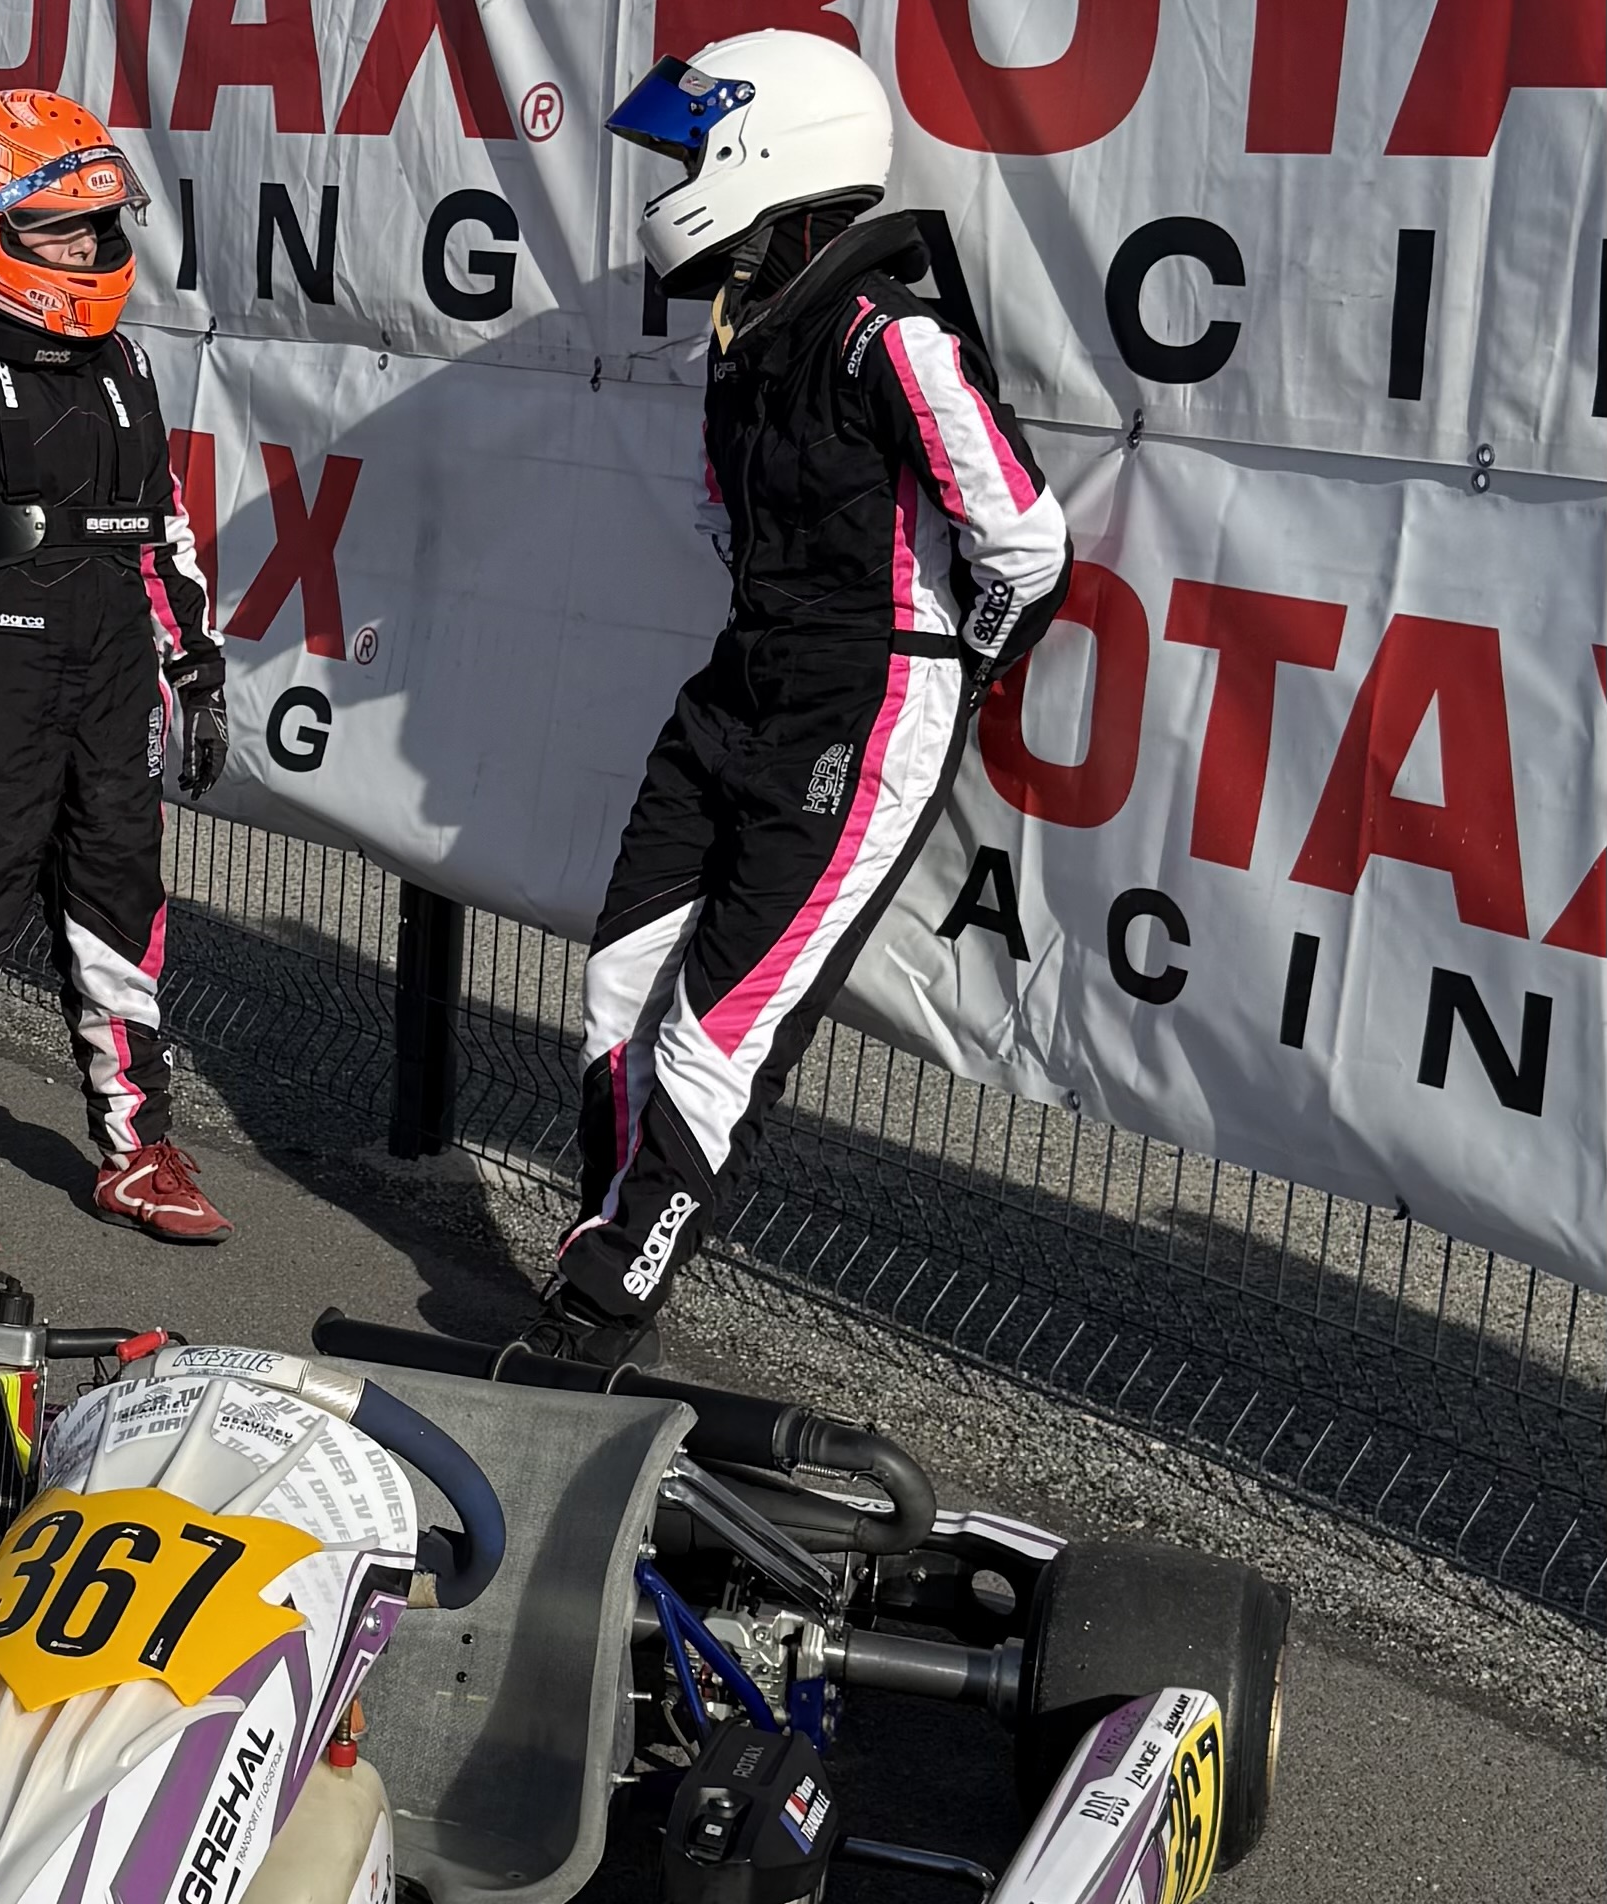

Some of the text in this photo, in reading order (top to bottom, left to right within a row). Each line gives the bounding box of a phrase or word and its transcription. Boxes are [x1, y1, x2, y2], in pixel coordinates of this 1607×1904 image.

[85, 516, 151, 532] BENGIO
[973, 580, 1016, 645] sparco
[622, 1190, 701, 1300] sparco
[221, 1415, 295, 1443] BEAULIEU
[733, 1744, 765, 1779] ROTAX
